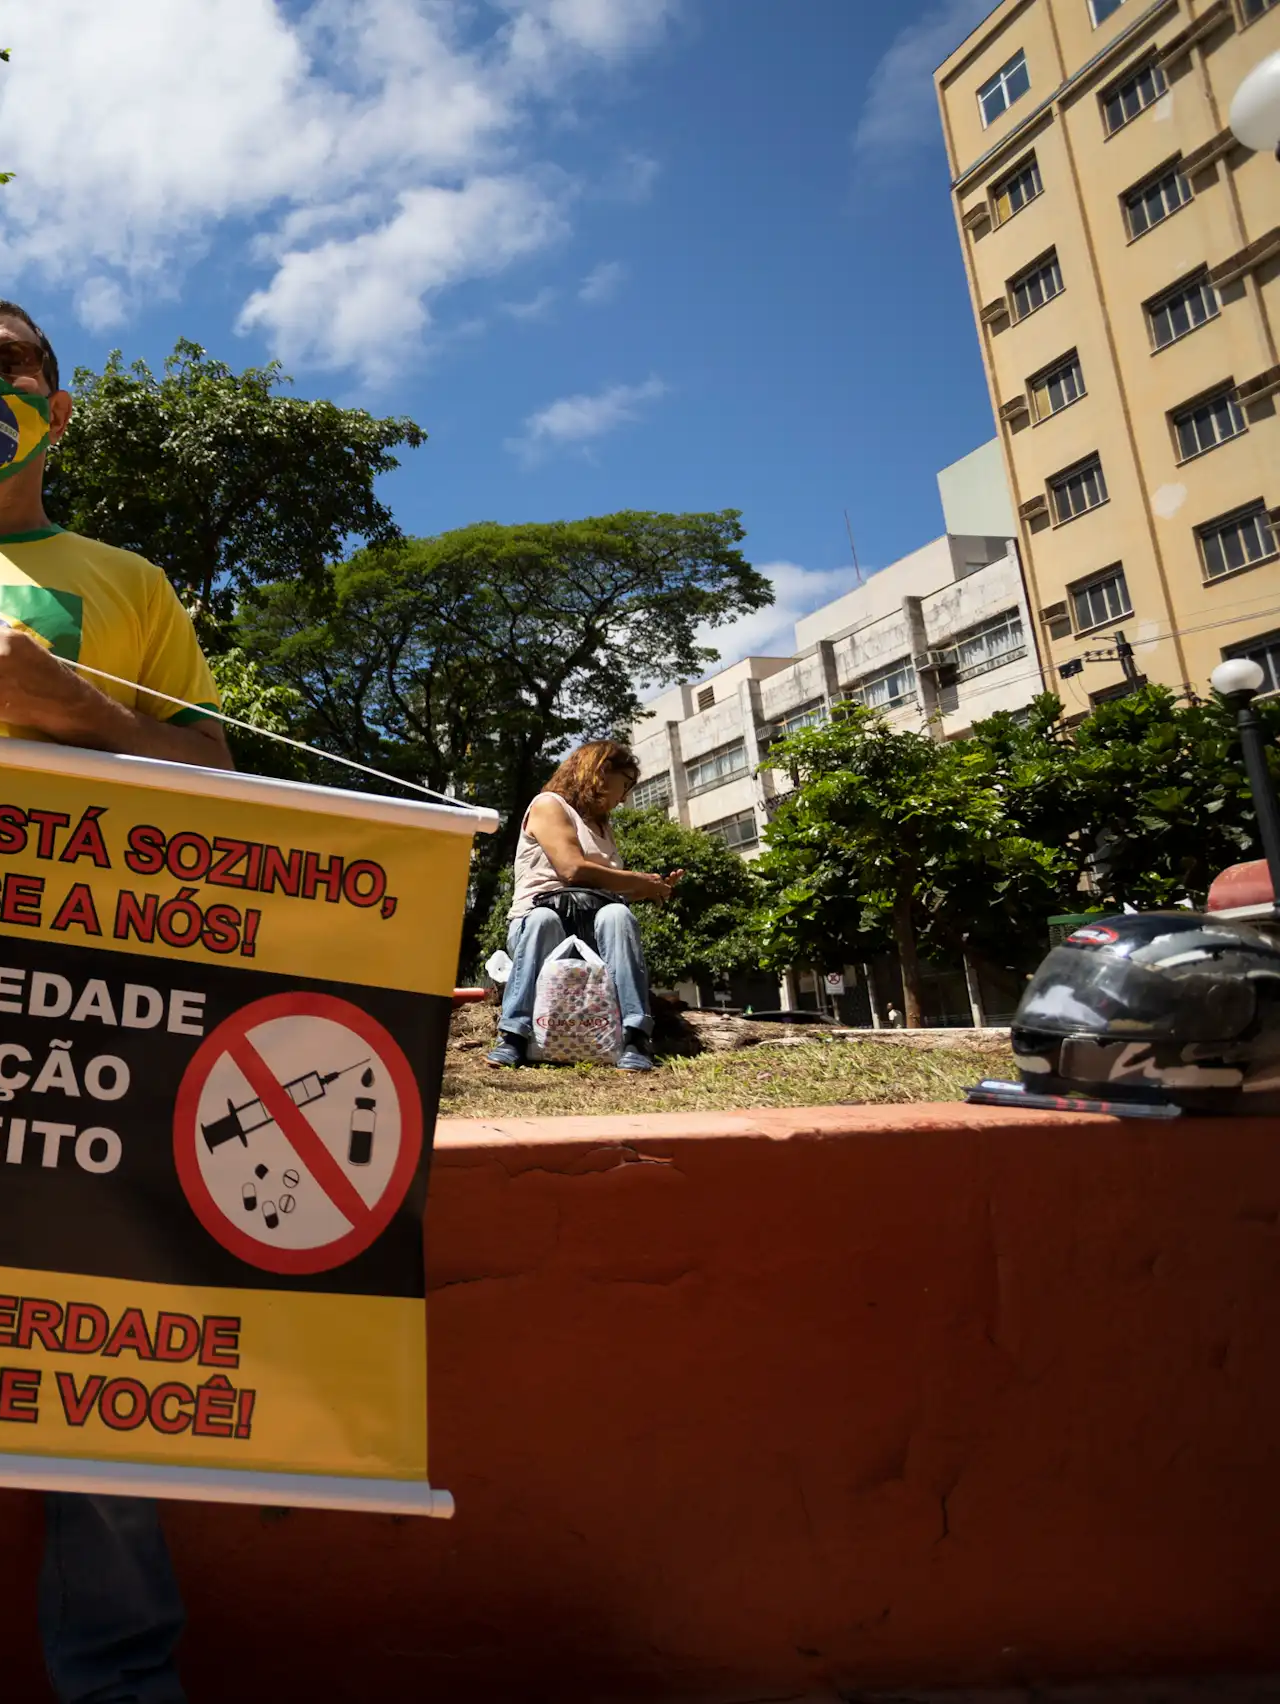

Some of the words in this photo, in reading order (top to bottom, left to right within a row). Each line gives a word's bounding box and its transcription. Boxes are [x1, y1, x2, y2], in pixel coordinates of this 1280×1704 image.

[125, 824, 398, 920] SOZINHO,
[51, 882, 102, 937] A
[114, 887, 262, 957] NÓS!
[55, 1374, 256, 1439] VOCÊ!
